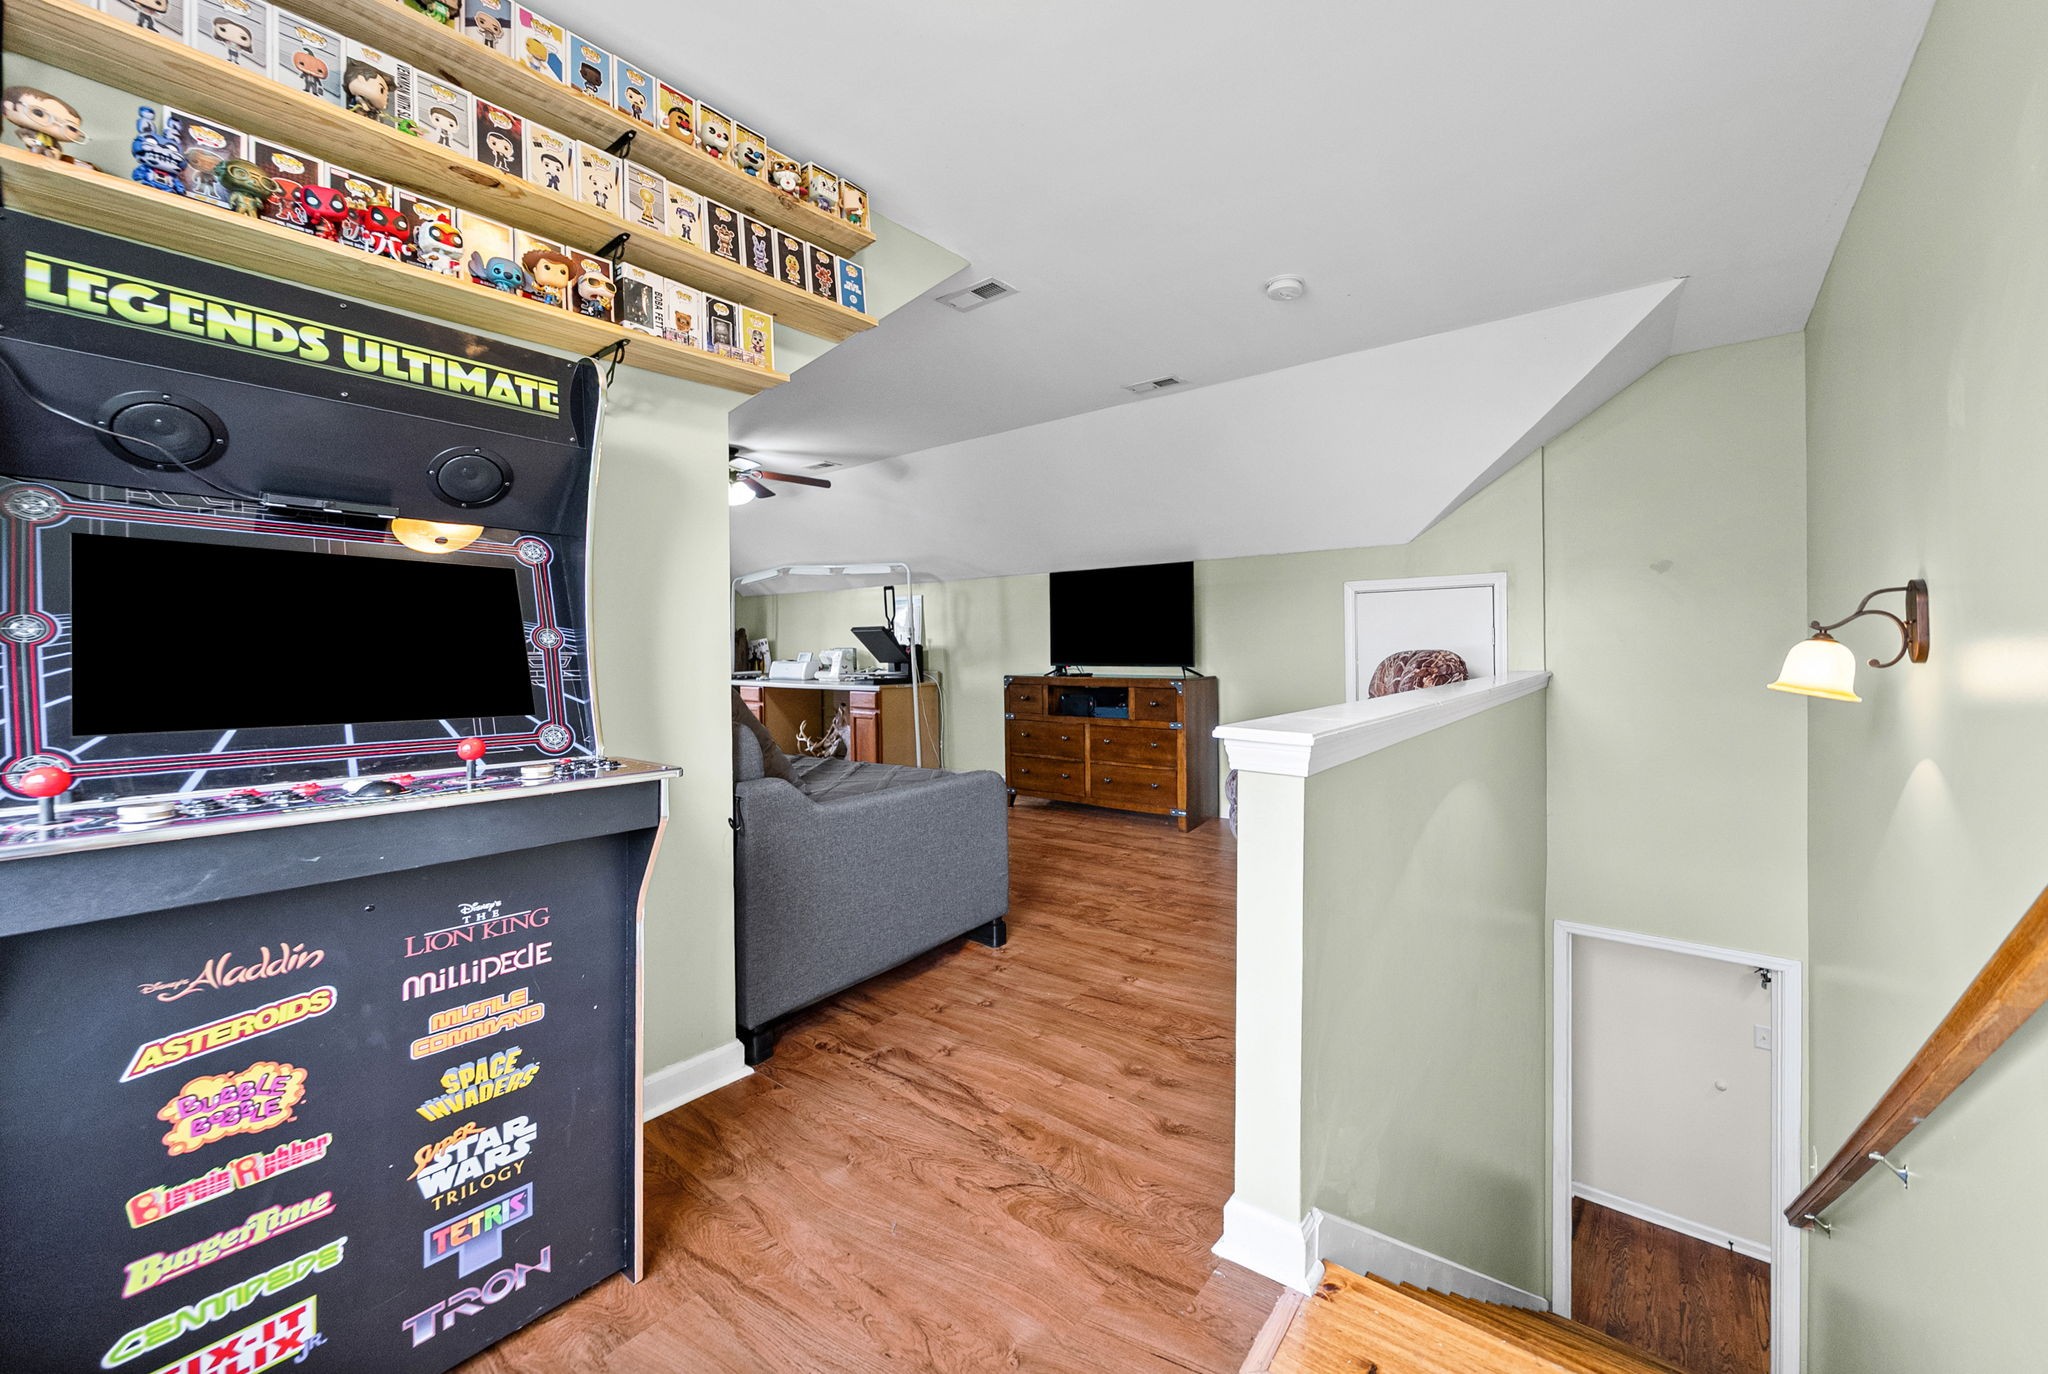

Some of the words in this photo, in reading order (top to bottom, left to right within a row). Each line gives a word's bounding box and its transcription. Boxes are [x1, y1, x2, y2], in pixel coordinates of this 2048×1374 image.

[25, 261, 330, 362] LEGENDS
[342, 334, 560, 414] ULTIMATE
[404, 925, 474, 958] LION
[481, 907, 550, 940] KING
[458, 900, 502, 915] Disney's
[462, 909, 501, 924] THE
[157, 942, 325, 1003] Aladdin
[122, 985, 336, 1081] ASTEROIDS
[410, 1002, 545, 1060] COMMAND
[429, 987, 529, 1034] MISSILE
[177, 1072, 293, 1119] BUBBLE
[415, 1063, 540, 1122] INVADERS
[440, 1046, 522, 1094] SPACE
[190, 1097, 283, 1137] BOBBLE
[417, 1115, 537, 1179] STAR
[417, 1131, 537, 1200] WARS
[431, 1160, 525, 1211] TRILOGY
[432, 1191, 528, 1255] TETRIS
[101, 1236, 348, 1369] CENTIPEDE
[402, 1245, 551, 1349] TRON
